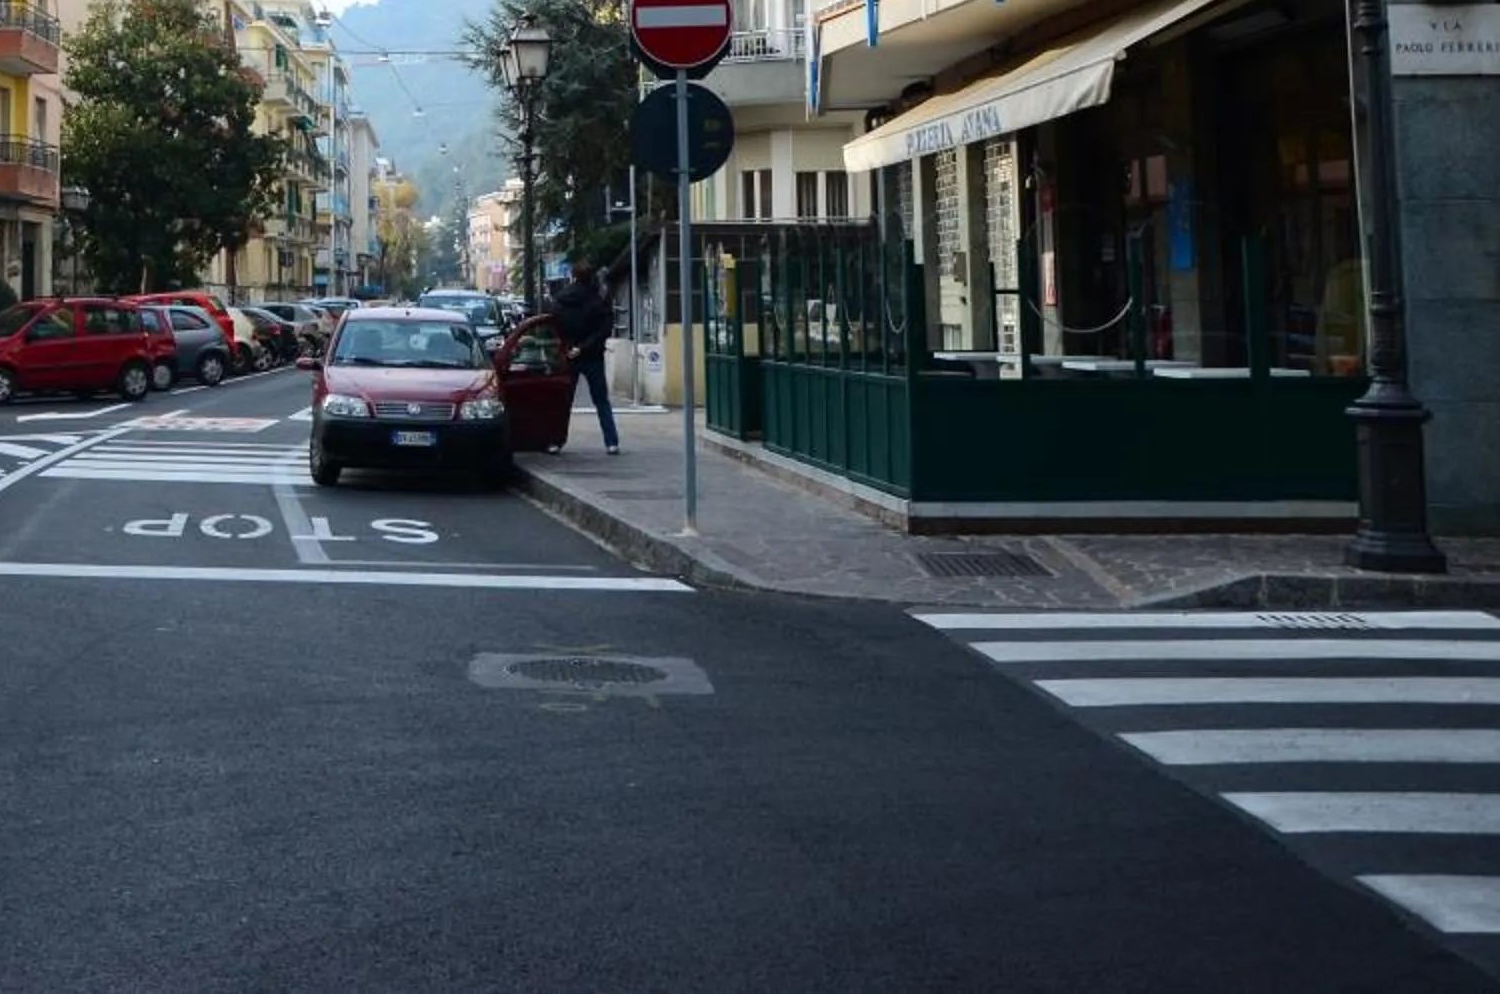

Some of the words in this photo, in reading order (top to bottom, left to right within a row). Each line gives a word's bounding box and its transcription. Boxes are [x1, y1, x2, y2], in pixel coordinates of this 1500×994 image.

[1429, 20, 1462, 31] VIA
[1395, 41, 1434, 54] PAOLO
[122, 511, 440, 544] STOP
